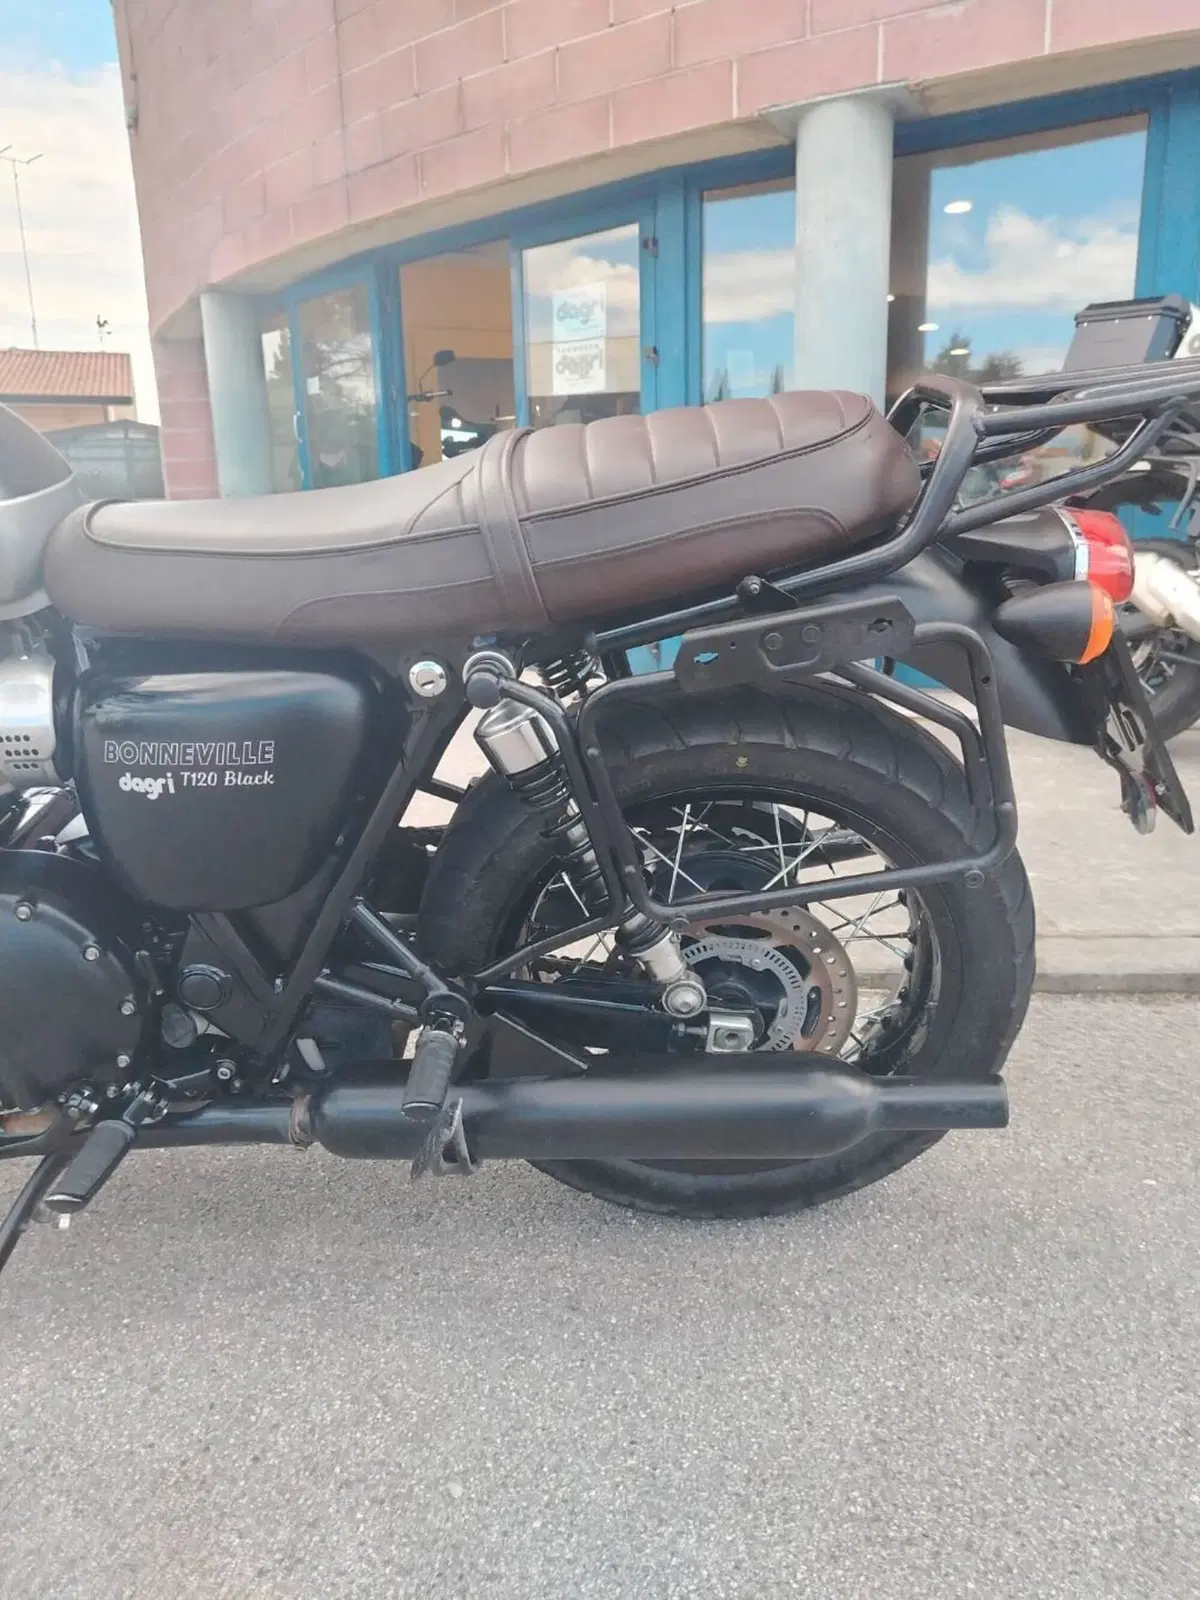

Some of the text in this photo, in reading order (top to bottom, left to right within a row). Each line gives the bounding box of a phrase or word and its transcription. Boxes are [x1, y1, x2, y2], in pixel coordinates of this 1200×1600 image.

[103, 740, 275, 766] BONNEVILLE
[118, 772, 175, 801] dagri
[180, 770, 275, 787] T120 Black
